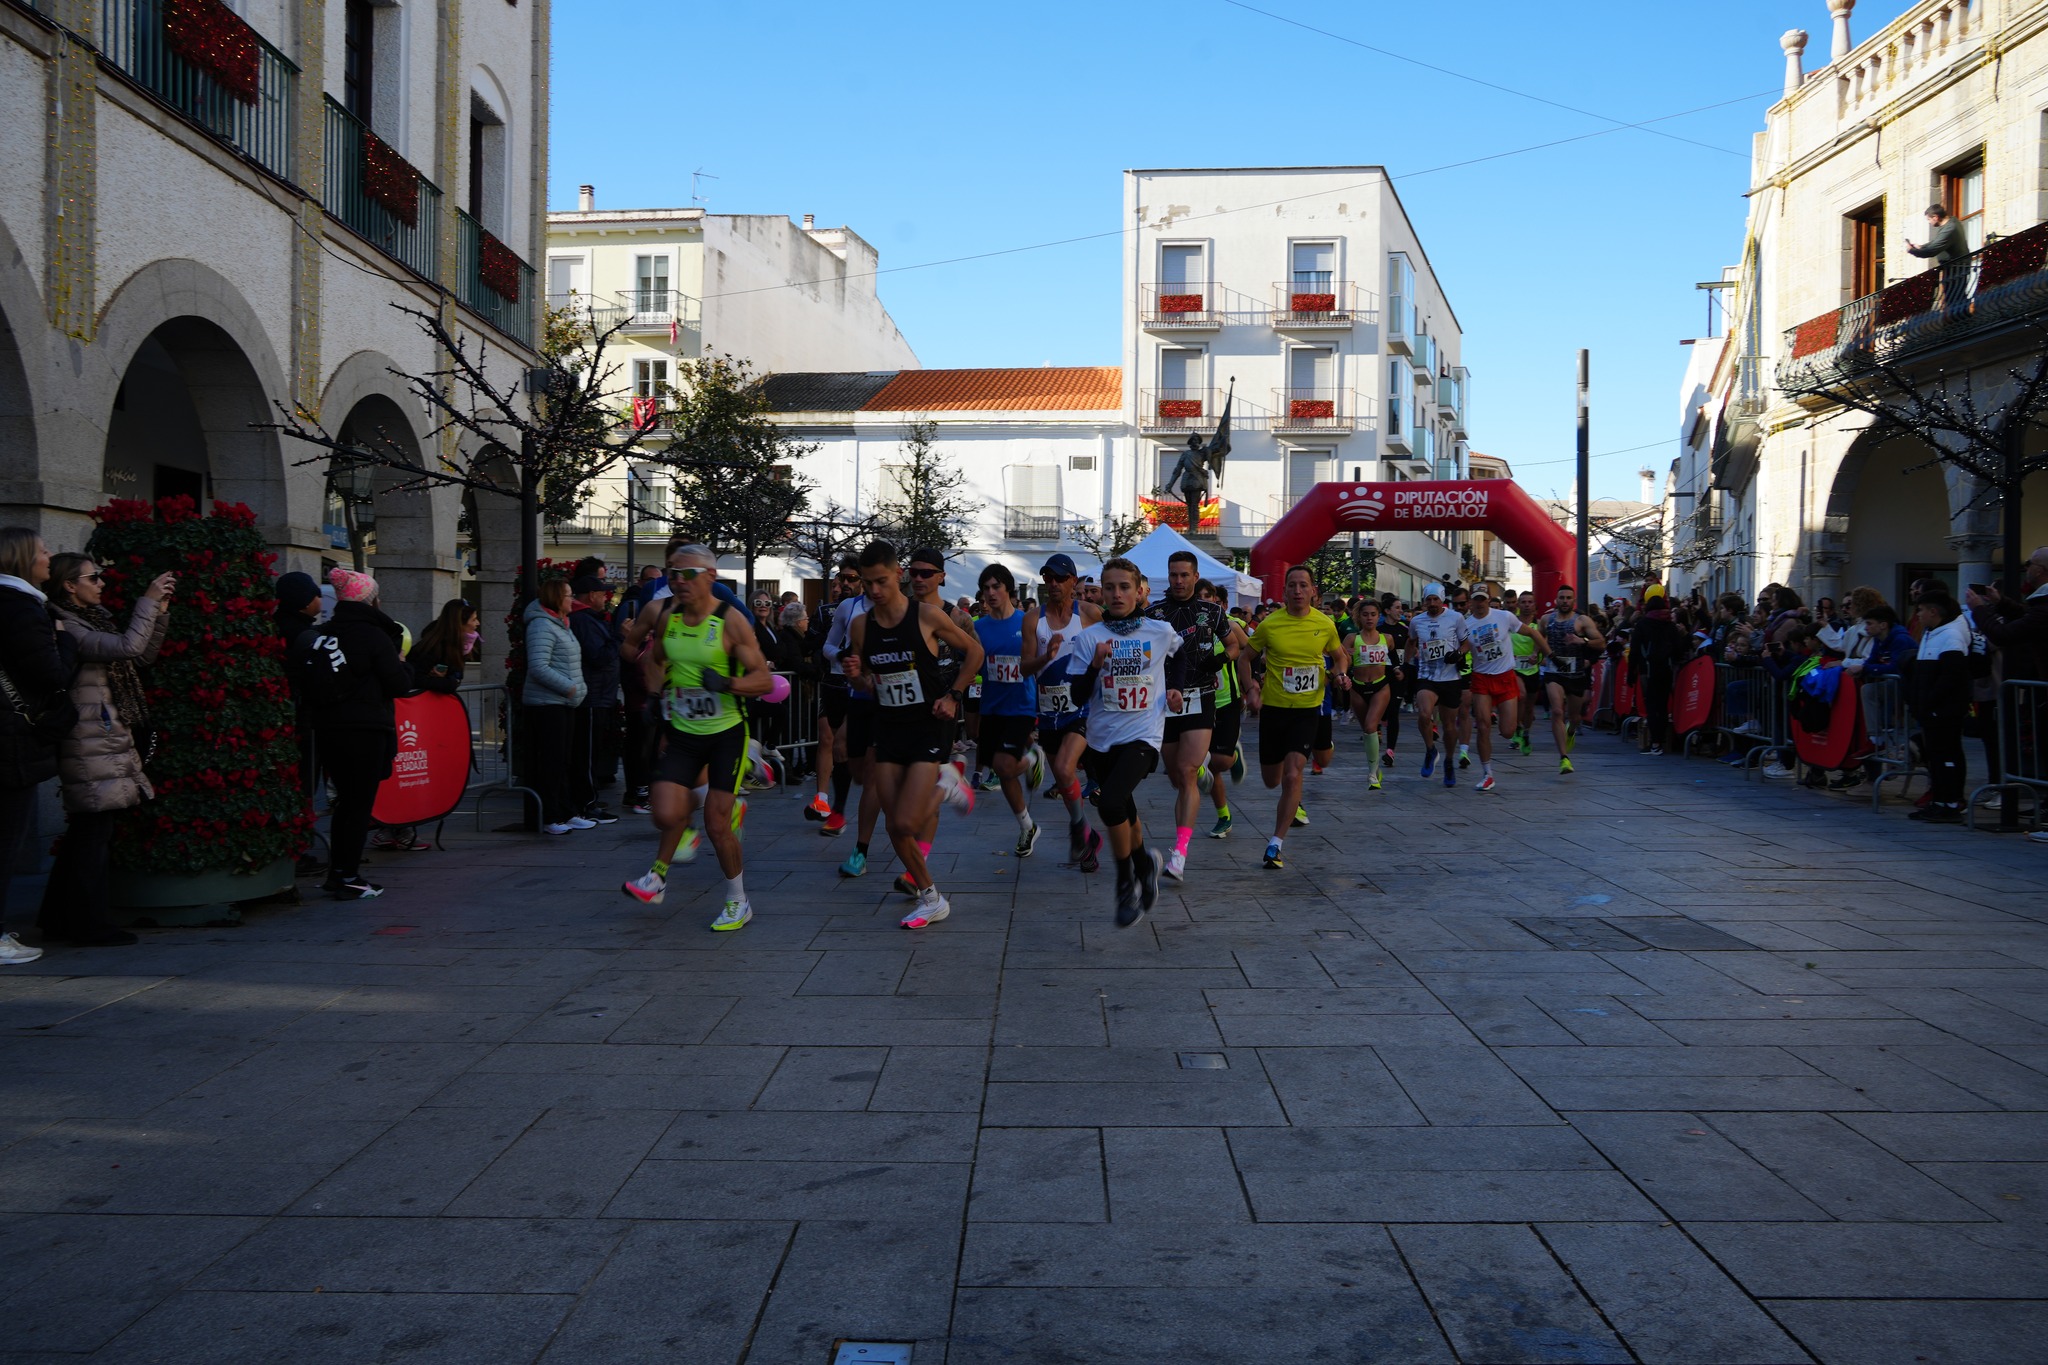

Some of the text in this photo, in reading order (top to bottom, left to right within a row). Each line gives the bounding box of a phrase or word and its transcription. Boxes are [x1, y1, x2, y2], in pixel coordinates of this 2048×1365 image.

[1394, 487, 1488, 504] DIPUTACIÓN
[1394, 504, 1488, 518] DE BADAJOZ
[1120, 640, 1141, 648] IMPOR
[1112, 648, 1142, 658] TANTE ES
[1369, 651, 1385, 663] 502
[1428, 645, 1445, 659] 297
[1112, 658, 1142, 666] PARTICIPAR
[997, 664, 1019, 681] 514
[1111, 665, 1141, 677] CORRO
[1295, 674, 1315, 691] 321
[887, 683, 916, 704] 175
[1118, 687, 1147, 710] 512
[1052, 695, 1069, 712] 92
[402, 760, 428, 771] BADAJOZ
